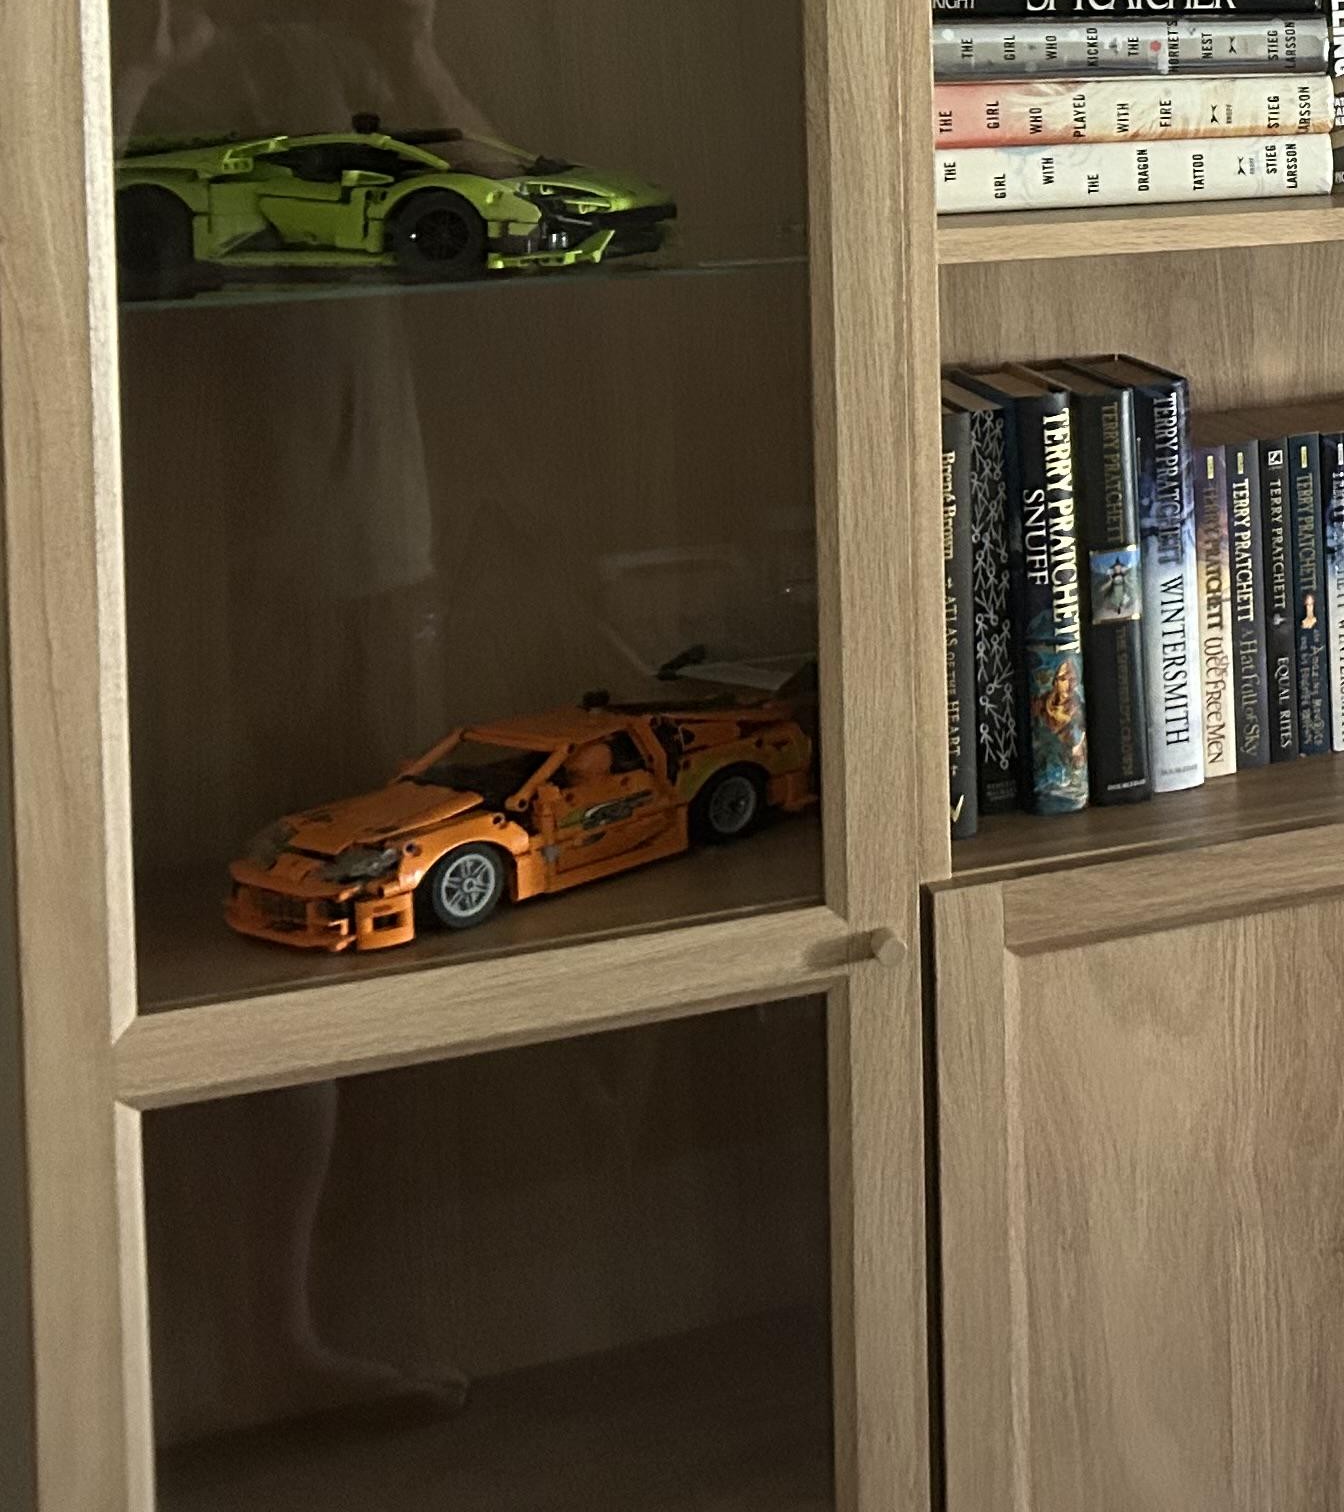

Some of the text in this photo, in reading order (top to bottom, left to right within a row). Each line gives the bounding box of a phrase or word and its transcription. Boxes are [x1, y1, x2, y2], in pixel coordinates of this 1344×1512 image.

[945, 143, 1297, 199] THE GIRL WITH THE DRAGON TATTOO STIEG LARSSON
[1024, 489, 1047, 584] SNUFF
[1043, 408, 1080, 653] TERRY PRATCHETT
[1160, 576, 1189, 746] WINTERSMITH
